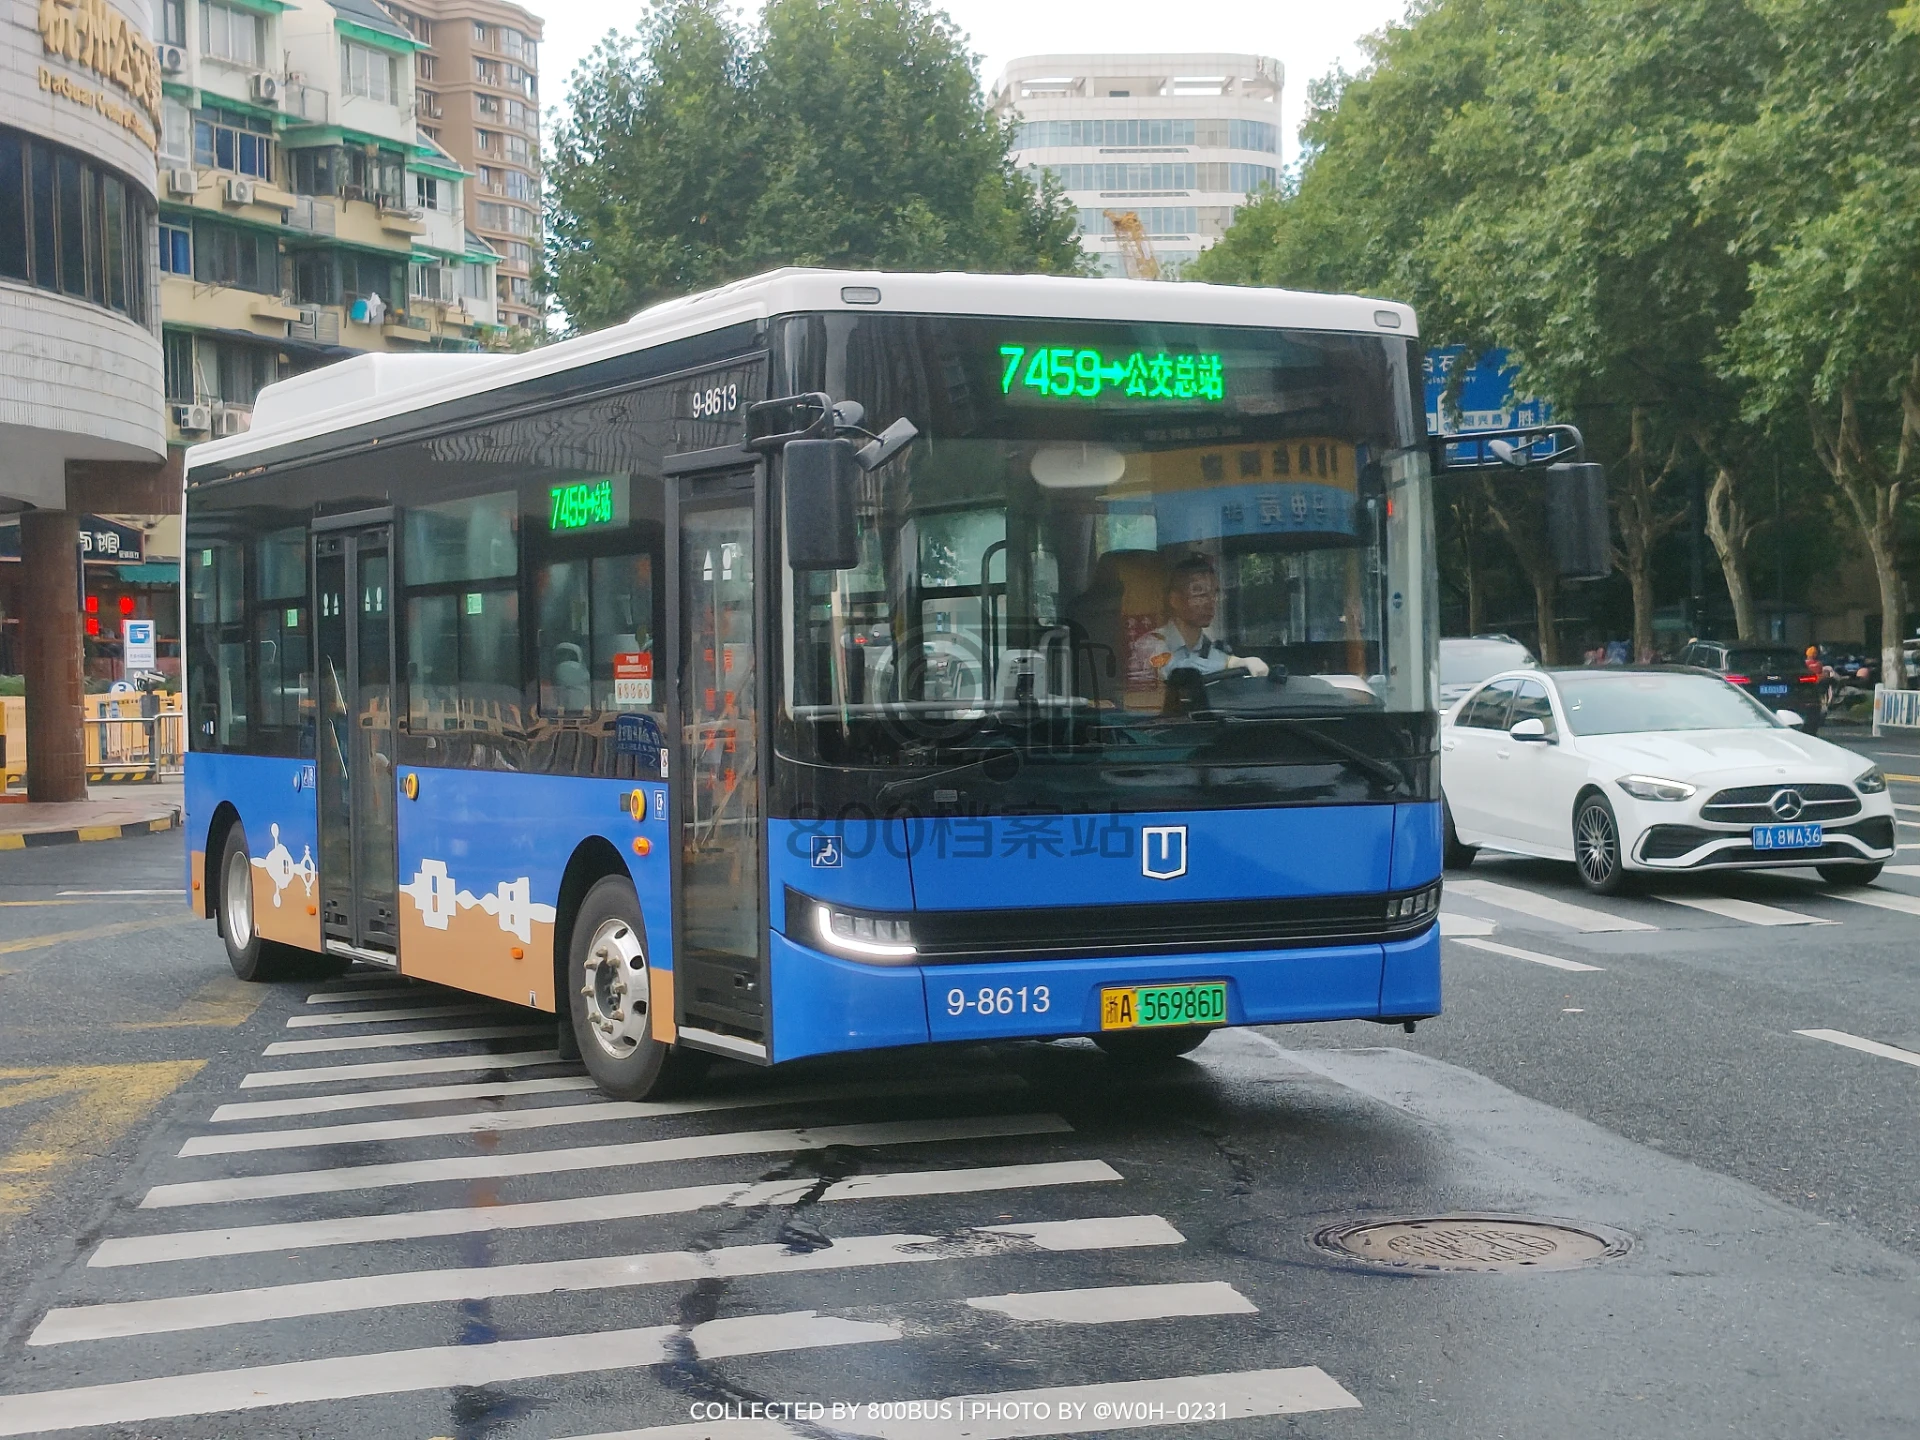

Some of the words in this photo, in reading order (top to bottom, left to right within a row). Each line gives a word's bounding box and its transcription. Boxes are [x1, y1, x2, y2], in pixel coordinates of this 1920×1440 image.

[999, 345, 1101, 397] 7459
[1126, 352, 1223, 400] 公交总站
[693, 383, 737, 418] 9-8613
[550, 484, 587, 530] 7459
[947, 985, 1050, 1016] 9-8613
